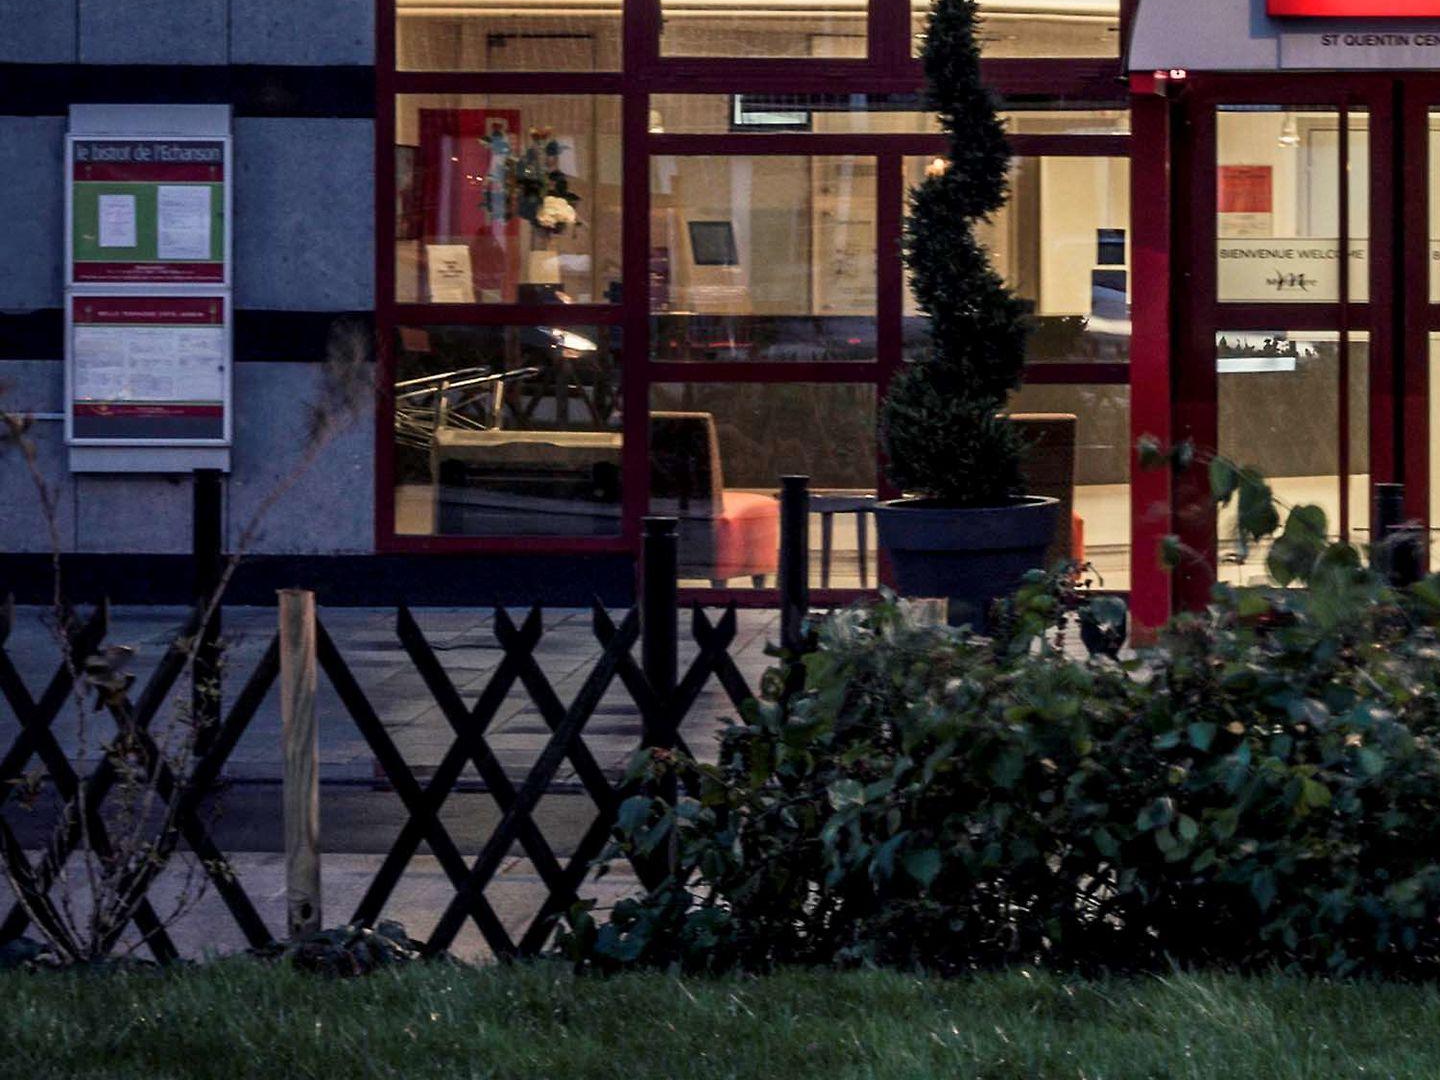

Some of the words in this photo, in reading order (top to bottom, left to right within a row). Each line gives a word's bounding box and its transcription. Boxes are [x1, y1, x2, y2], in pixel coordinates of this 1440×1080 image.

[1321, 34, 1338, 46] ST
[1344, 34, 1410, 47] QUENTIN
[134, 144, 150, 161] de
[1219, 248, 1294, 259] BIENVENUE
